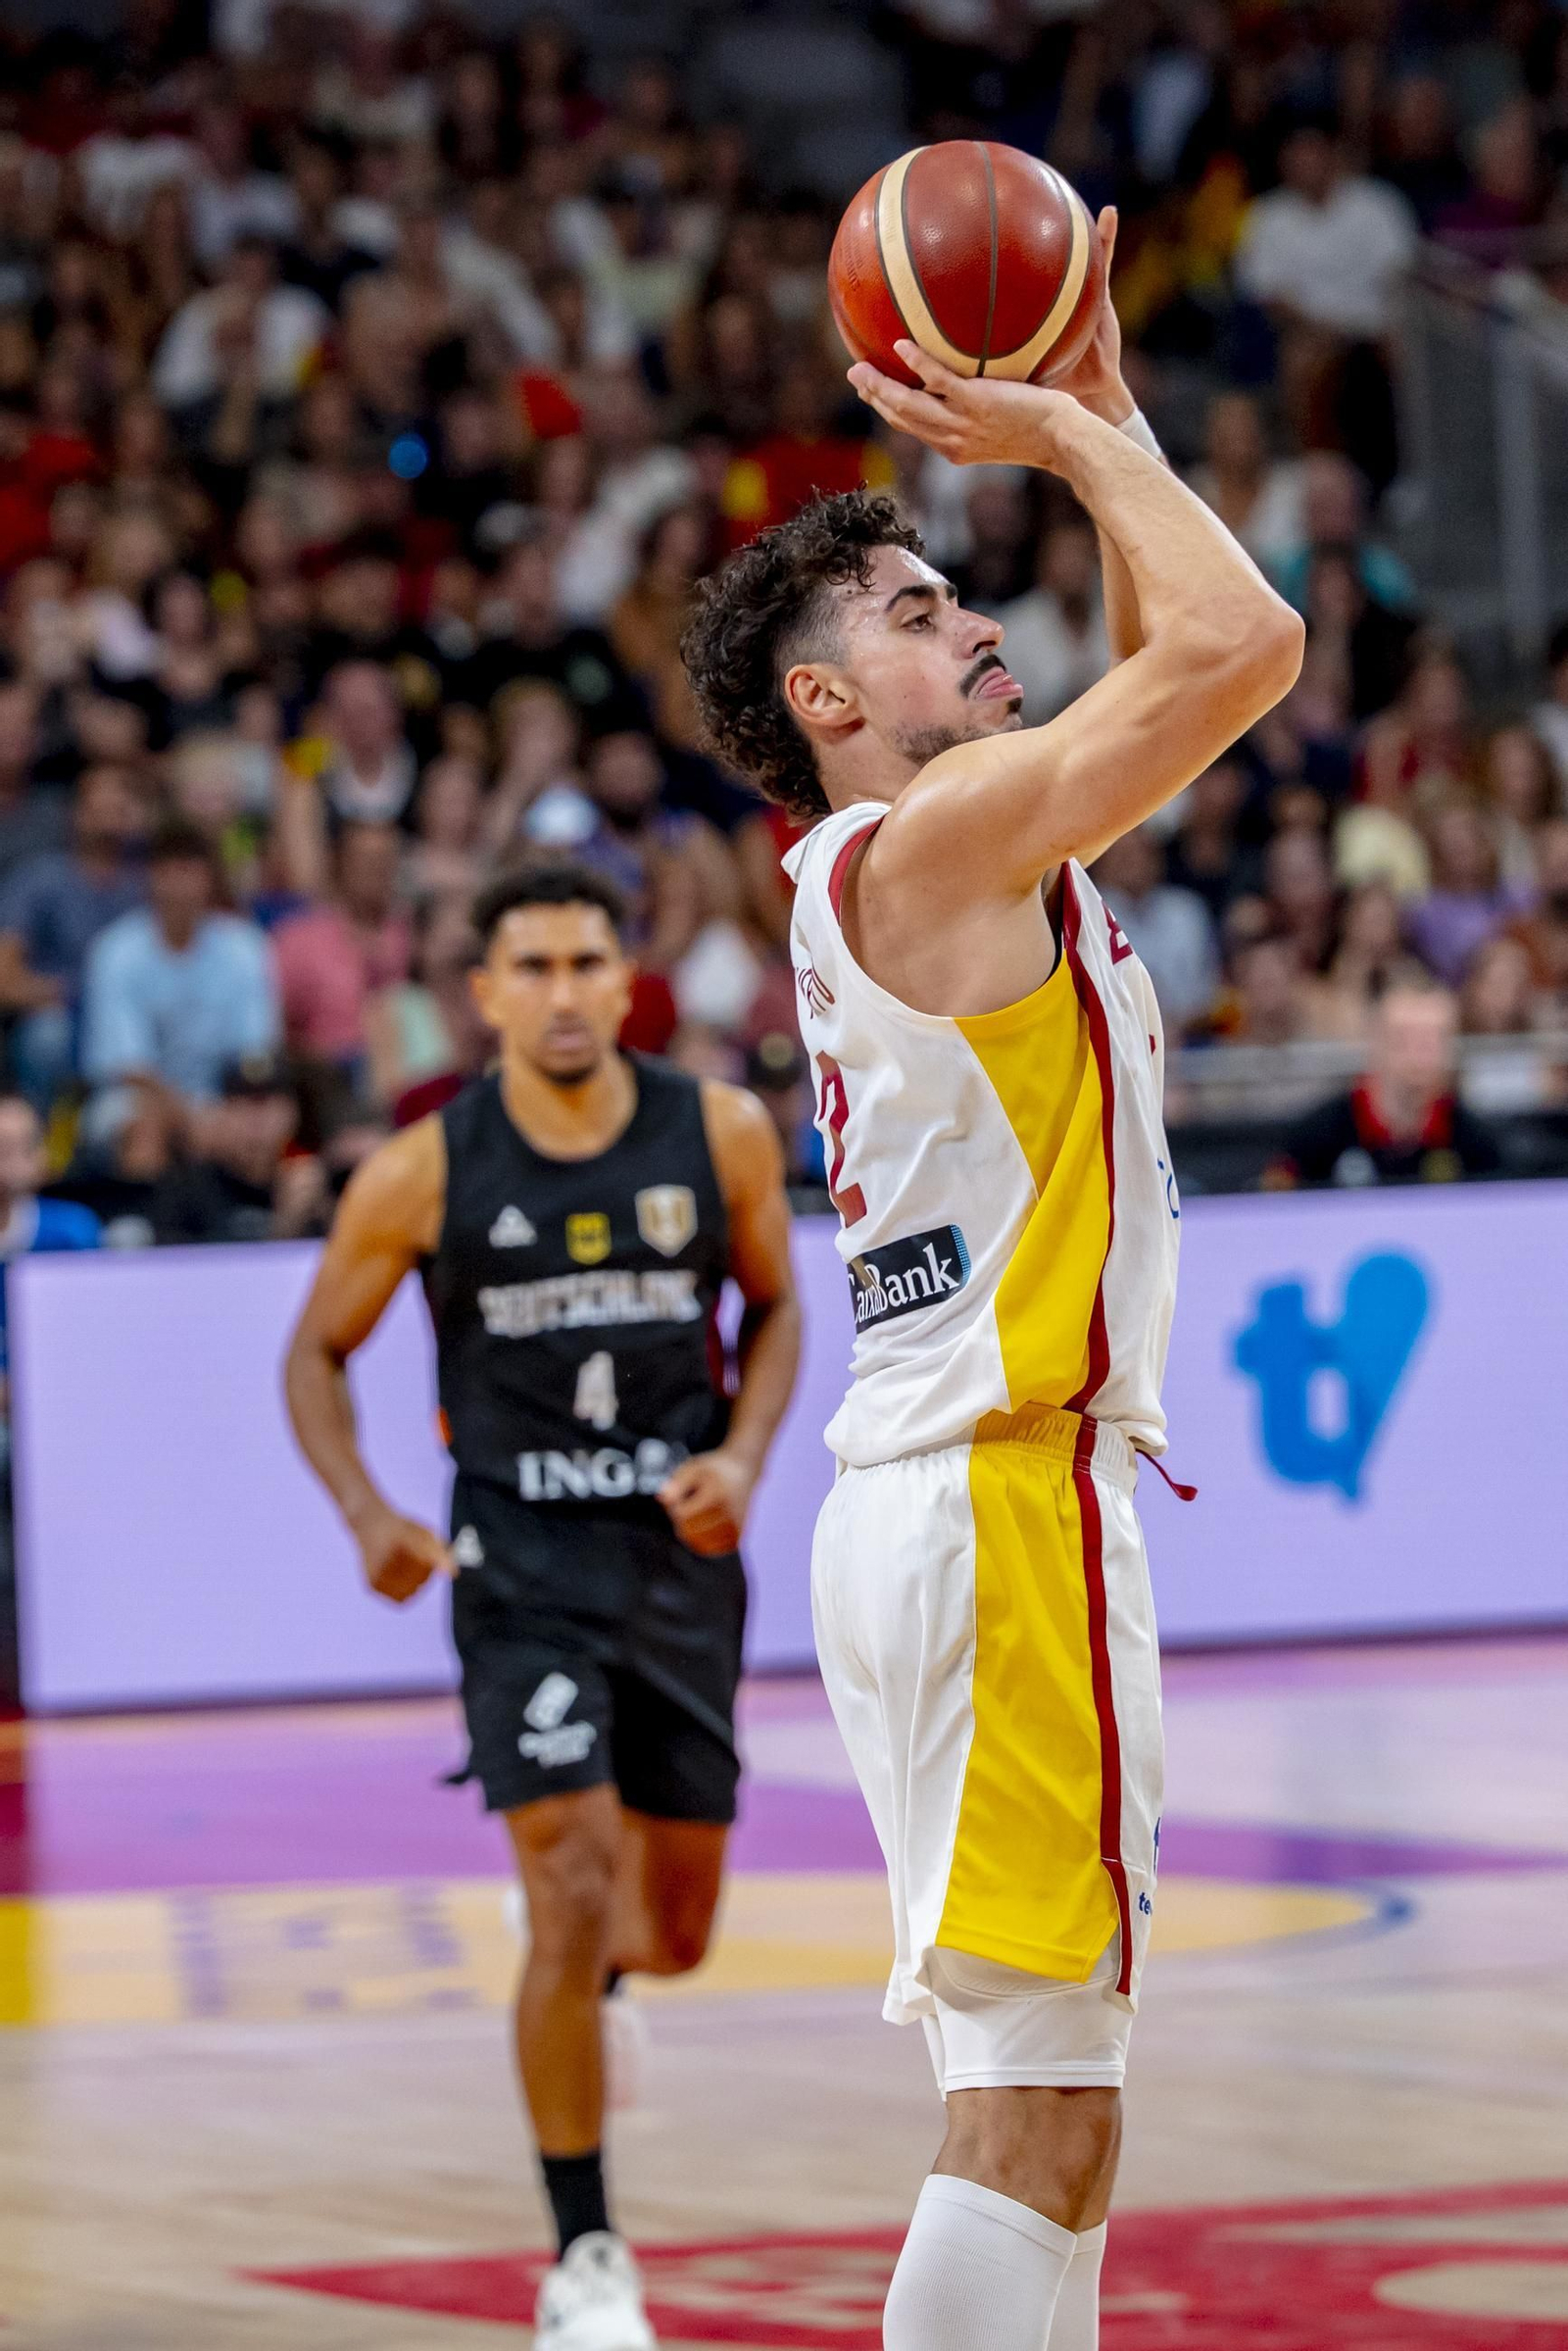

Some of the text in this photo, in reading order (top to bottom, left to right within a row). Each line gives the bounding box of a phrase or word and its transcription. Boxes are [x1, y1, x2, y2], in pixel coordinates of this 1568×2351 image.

[573, 1349, 619, 1431] 4
[518, 1447, 637, 1501] ING
[1139, 1891, 1152, 1916] te
